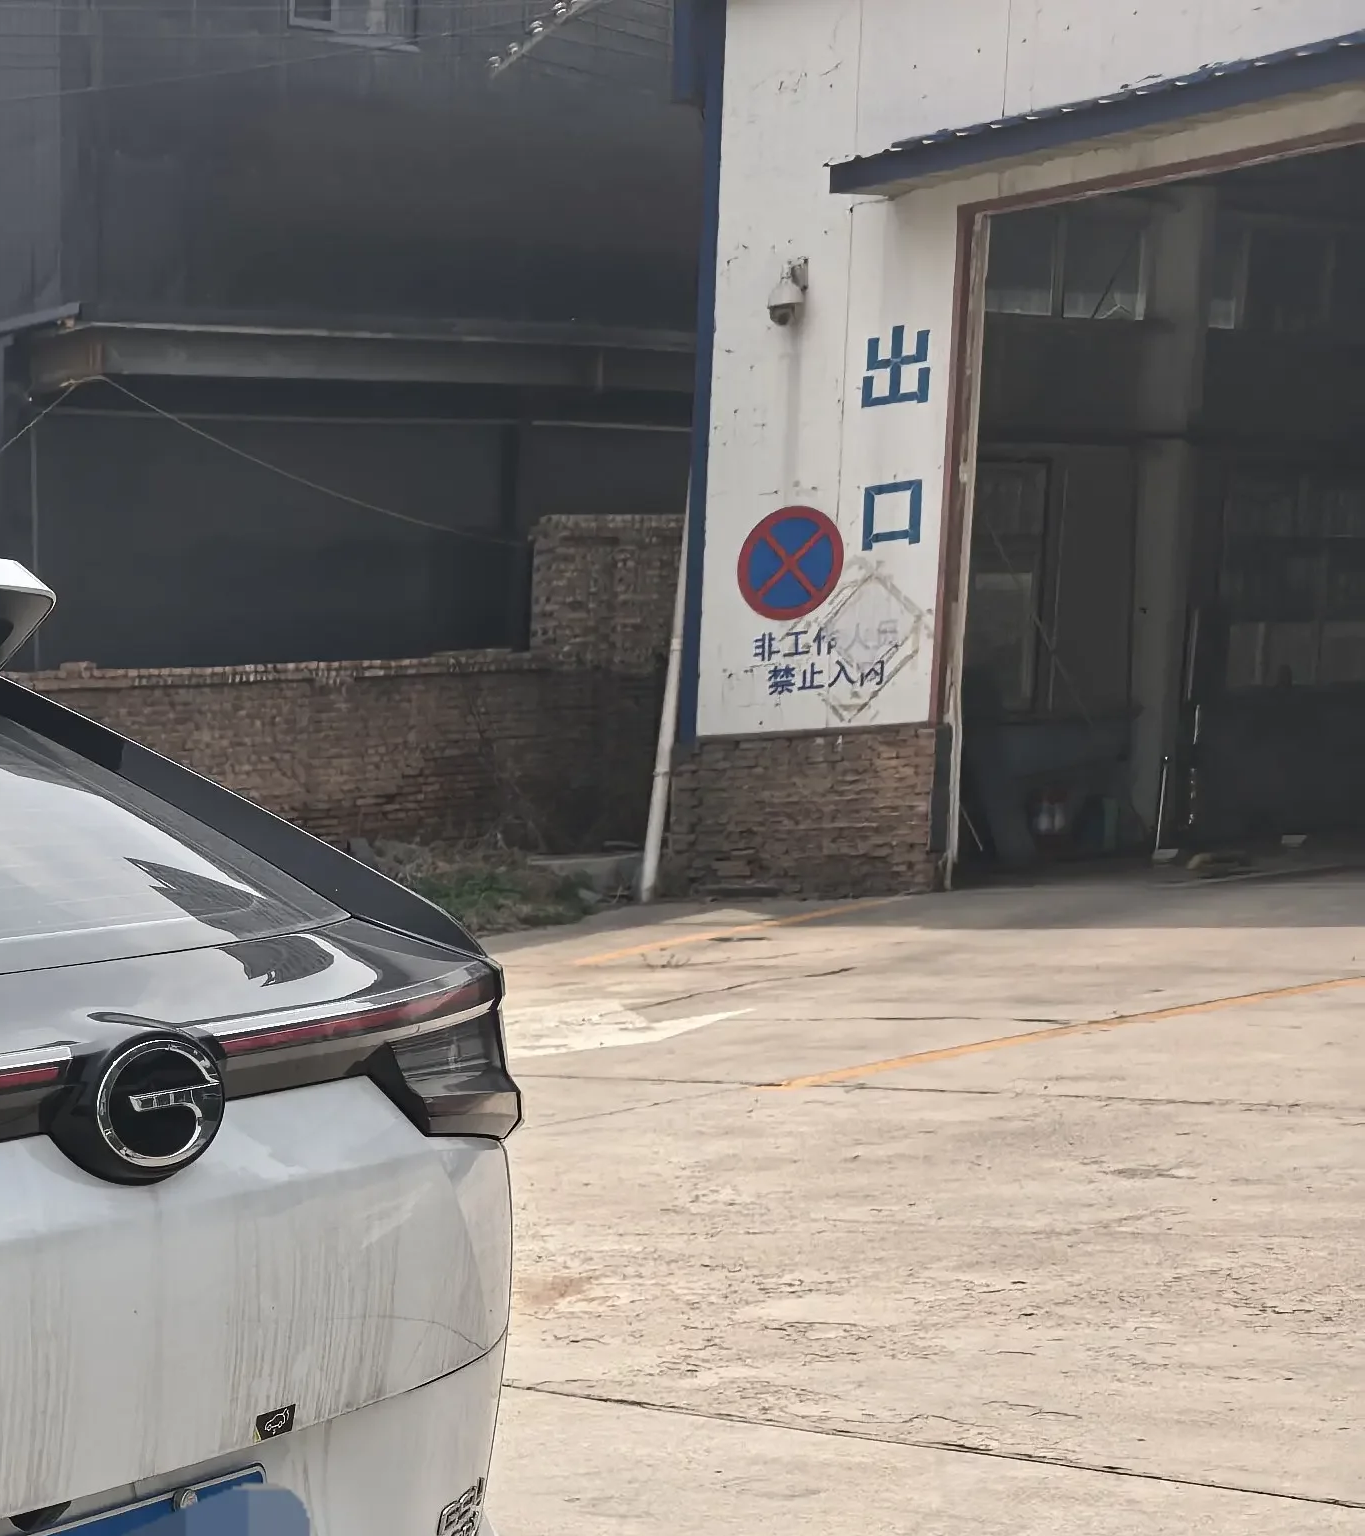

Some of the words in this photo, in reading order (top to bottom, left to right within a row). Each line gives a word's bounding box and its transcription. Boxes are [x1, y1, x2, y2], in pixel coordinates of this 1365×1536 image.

[861, 325, 930, 551] 出口
[768, 661, 885, 696] 禁止入内
